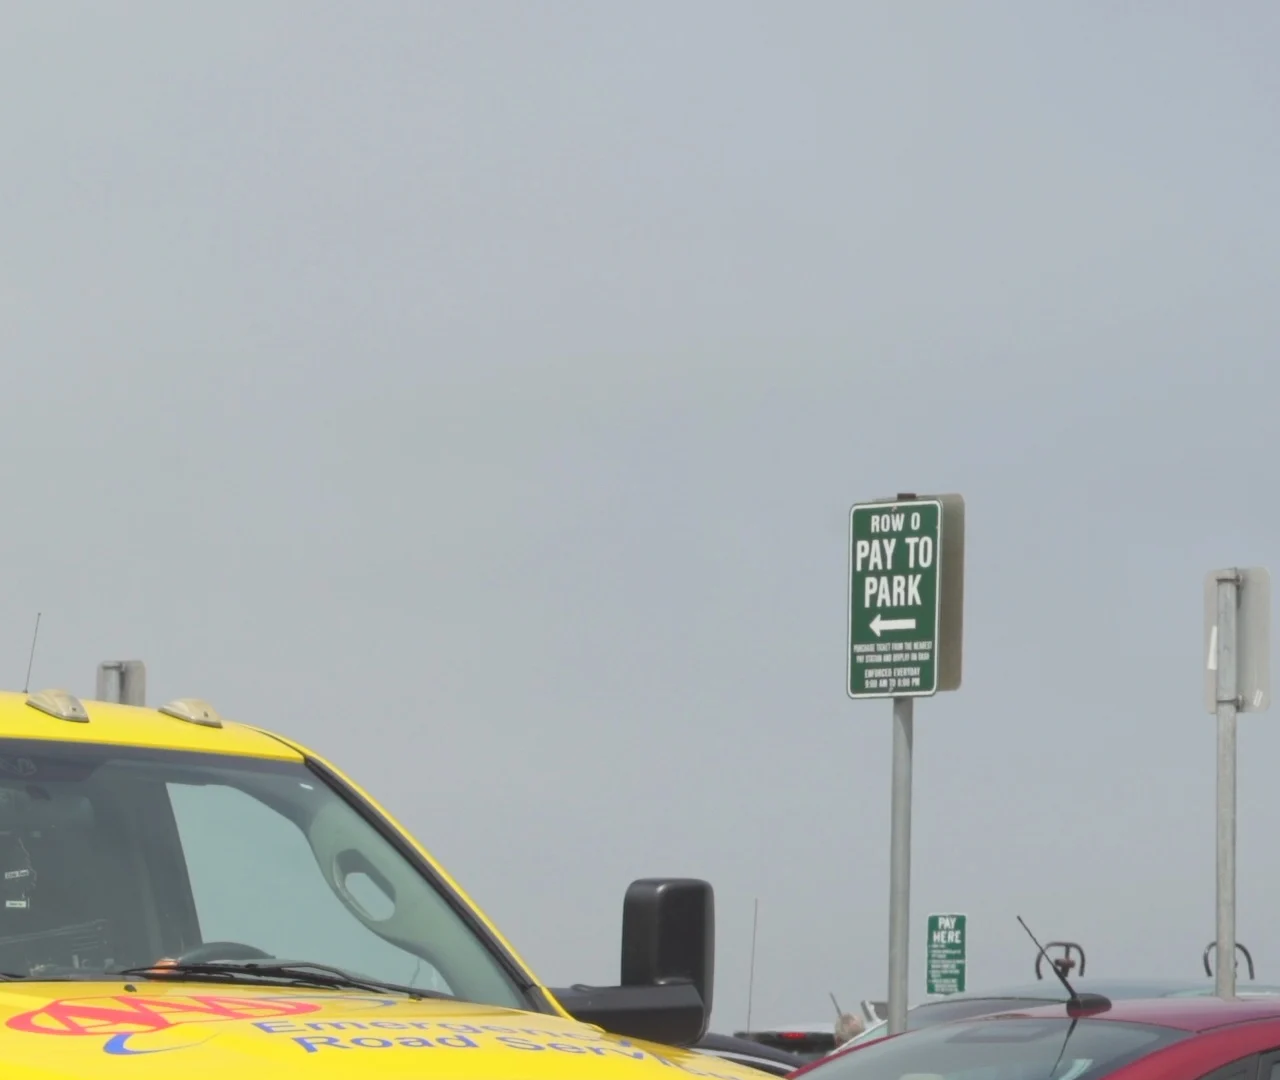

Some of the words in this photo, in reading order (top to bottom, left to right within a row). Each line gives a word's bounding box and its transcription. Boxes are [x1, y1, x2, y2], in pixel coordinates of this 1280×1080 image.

[871, 514, 904, 533] ROW
[856, 538, 897, 572] PAY
[905, 536, 933, 568] TO
[864, 574, 922, 608] PARK
[938, 917, 956, 930] PAY
[933, 930, 961, 943] HERE
[291, 1034, 480, 1054] Road
